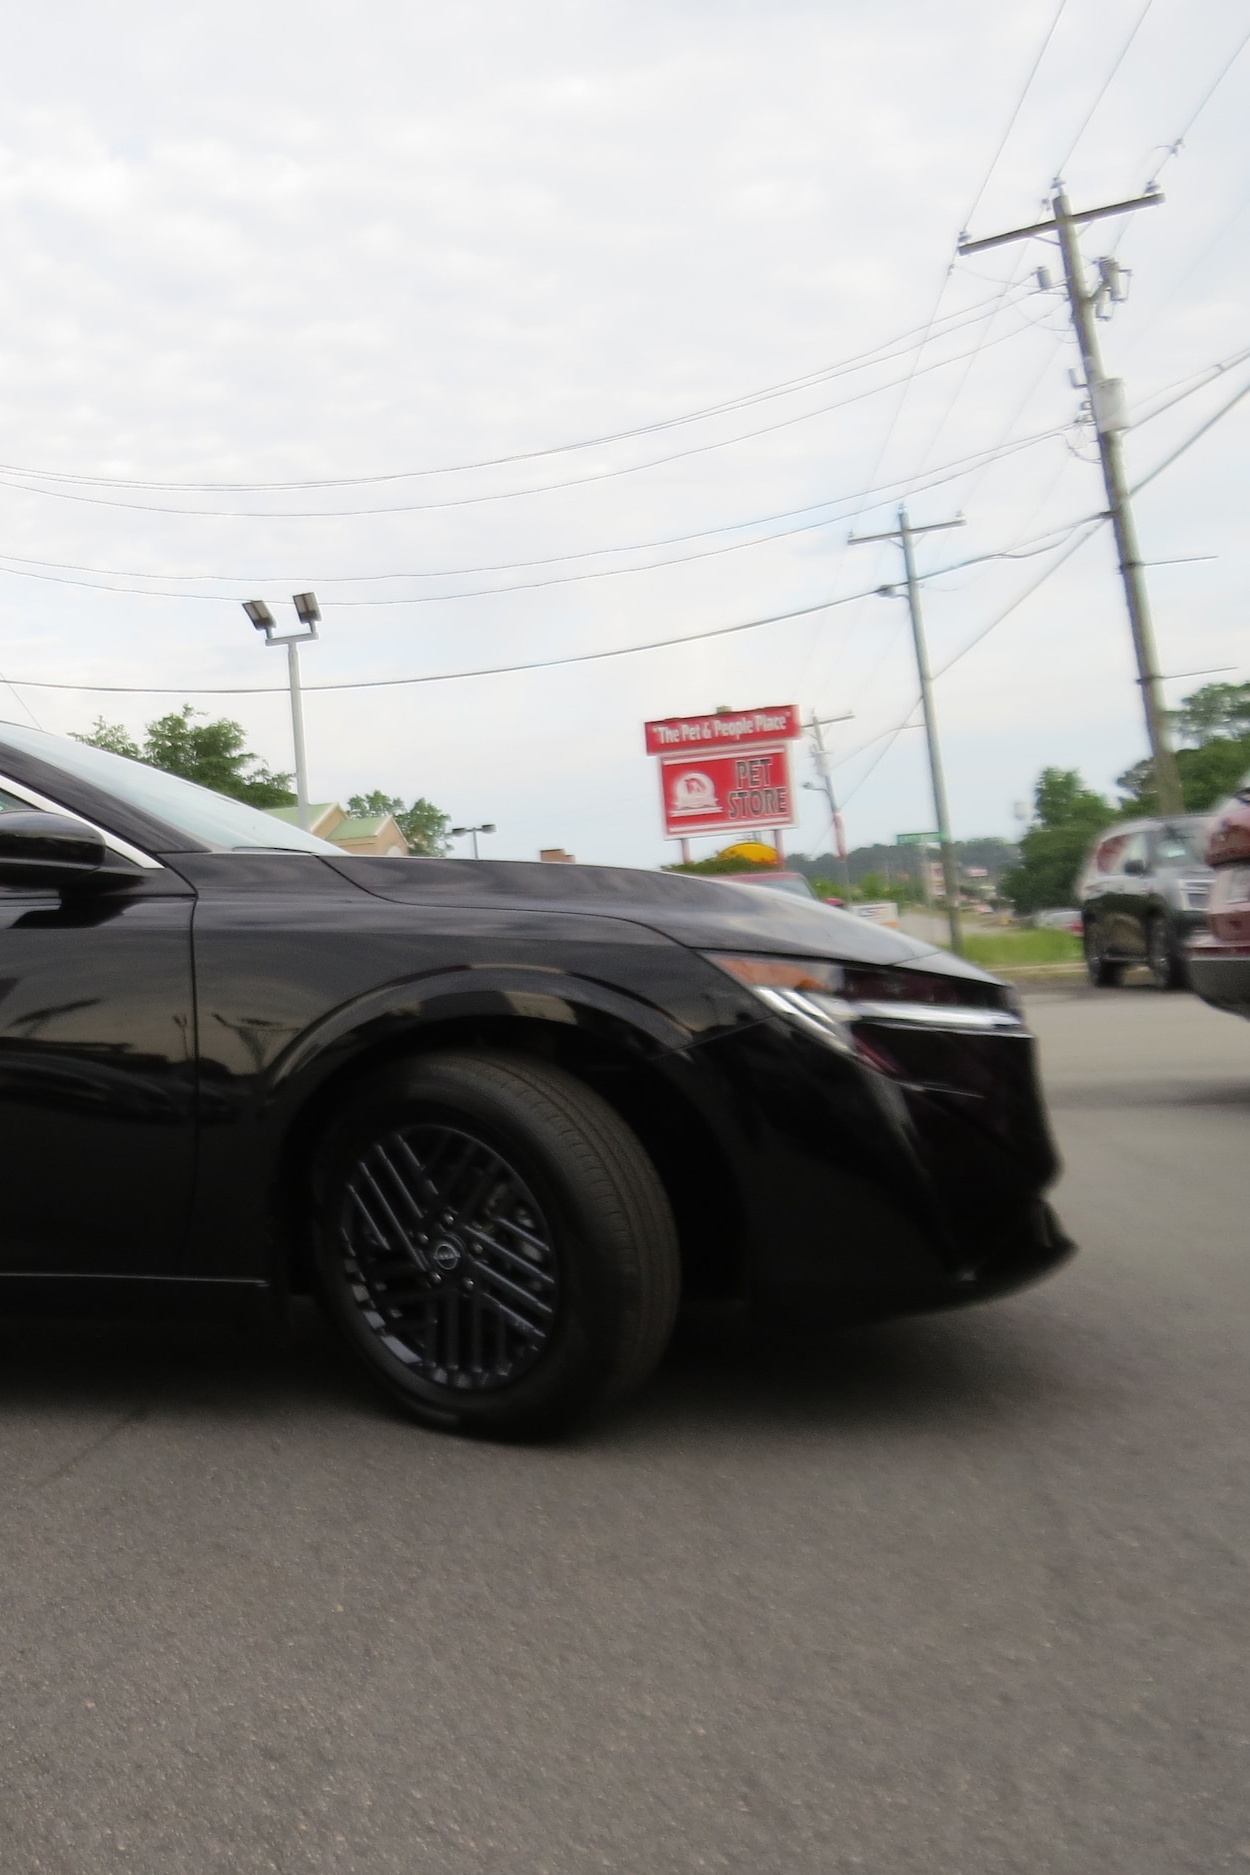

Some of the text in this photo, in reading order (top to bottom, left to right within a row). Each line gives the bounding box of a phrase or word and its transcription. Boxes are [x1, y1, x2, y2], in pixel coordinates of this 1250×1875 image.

[682, 723, 700, 742] Pet
[702, 722, 712, 739] &
[714, 717, 754, 741] People
[735, 757, 773, 789] PET
[728, 786, 789, 820] STORE
